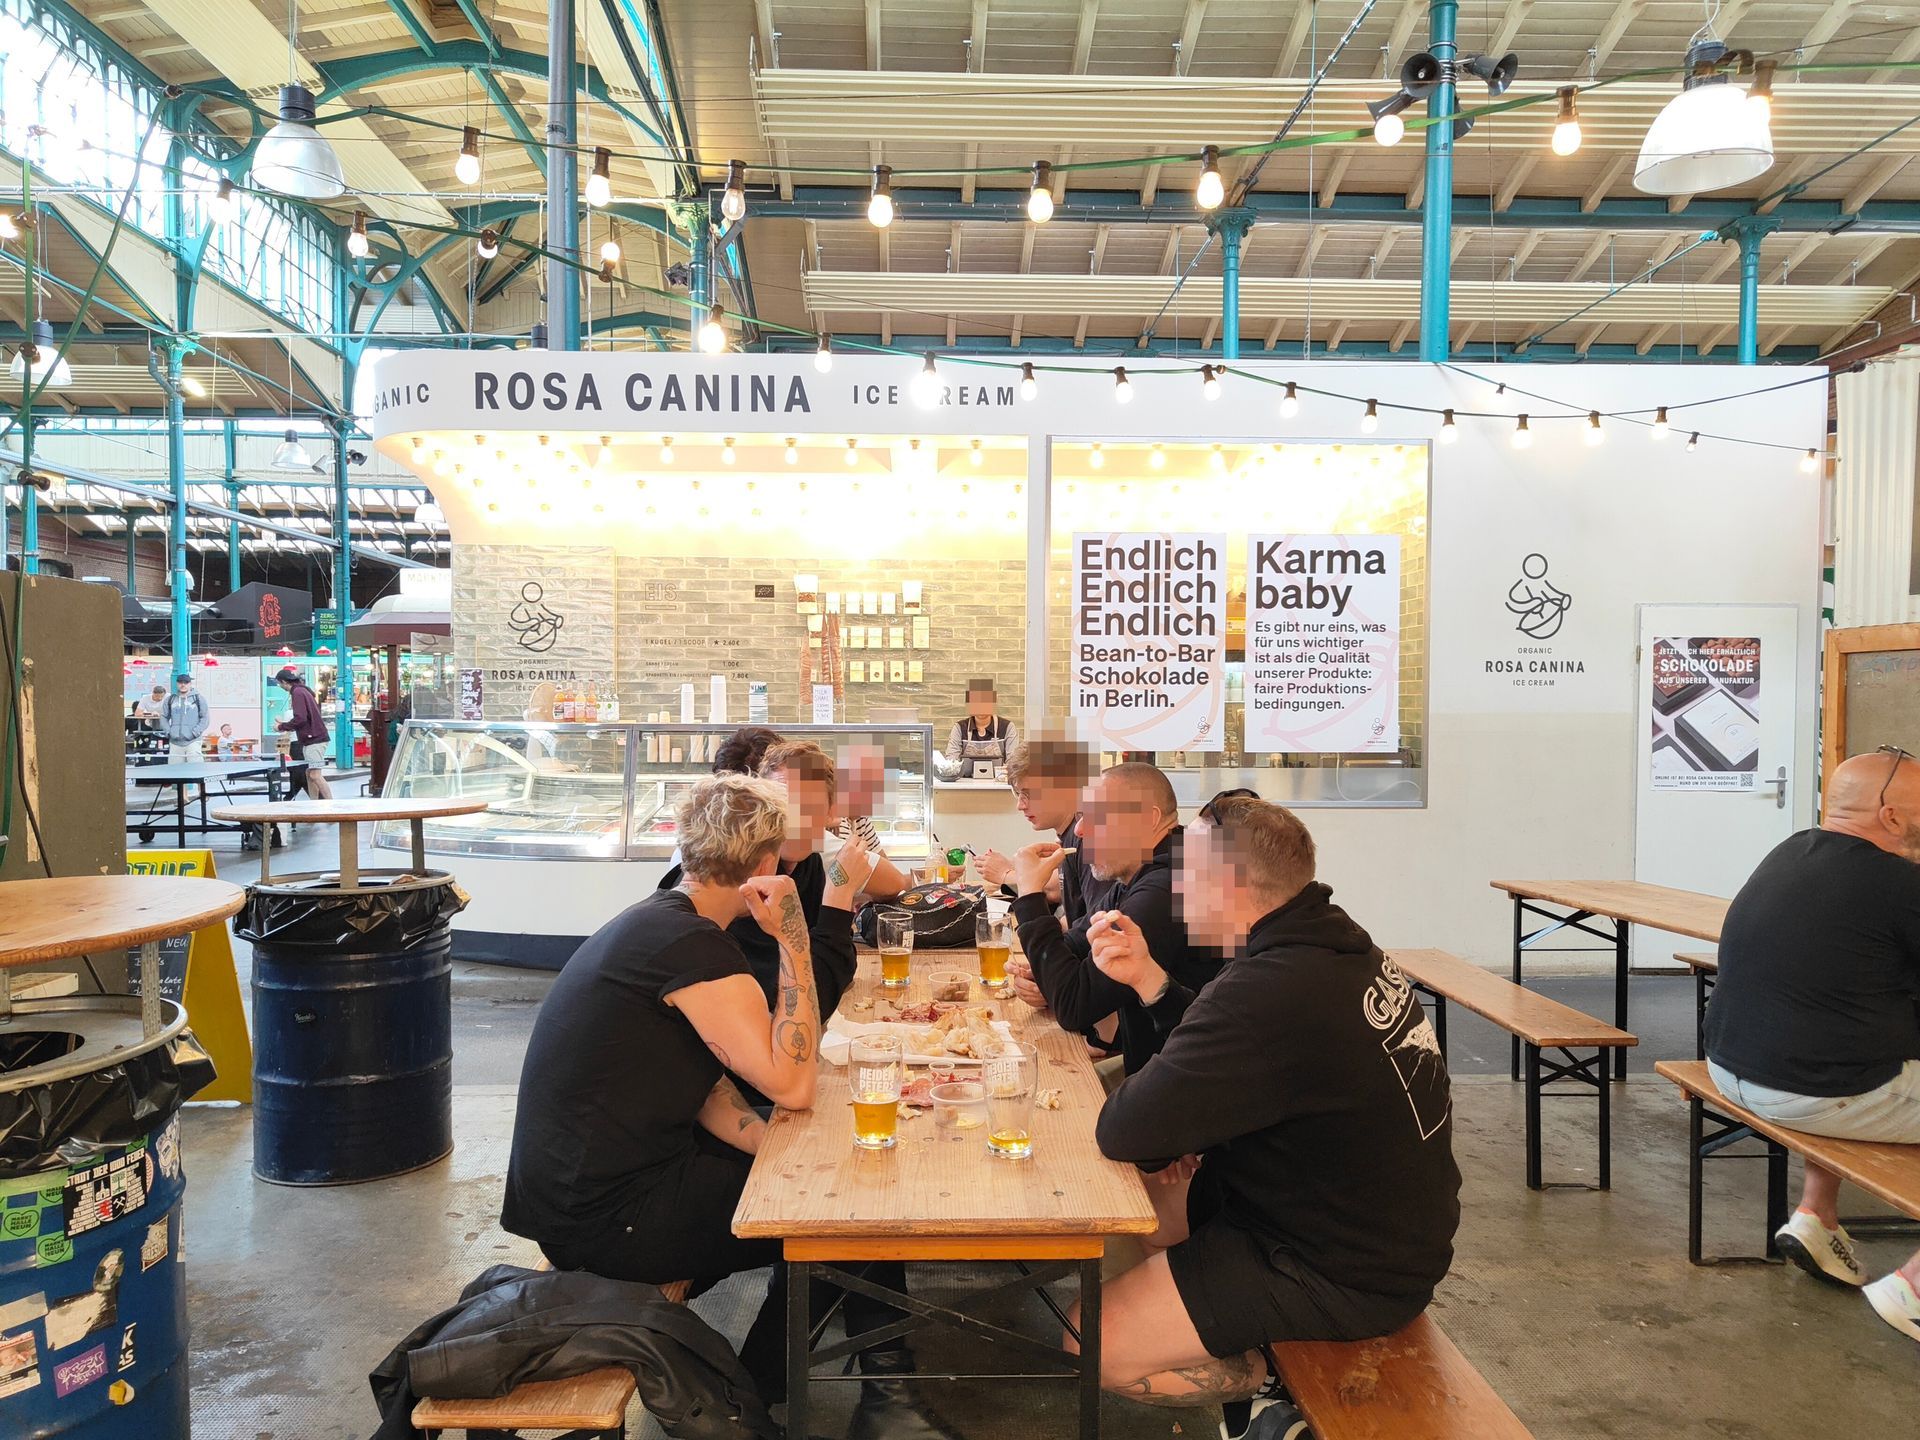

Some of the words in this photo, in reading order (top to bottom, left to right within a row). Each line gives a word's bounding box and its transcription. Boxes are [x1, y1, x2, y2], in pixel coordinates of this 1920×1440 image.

[474, 371, 603, 411] ROSA
[625, 372, 811, 413] CANINA
[853, 385, 898, 404] ICE
[925, 386, 1014, 406] REAM
[1081, 539, 1217, 571] Endlich
[1256, 541, 1386, 574] Karma
[645, 583, 677, 601] EIS
[1081, 572, 1217, 604] Endlich
[1255, 576, 1353, 618] baby
[1080, 605, 1216, 636] Endlich
[1255, 621, 1271, 633] Es
[1274, 621, 1300, 637] gibt
[1303, 623, 1325, 633] nur
[1328, 621, 1358, 635] eins,
[1361, 623, 1387, 633] was
[1254, 636, 1274, 648] für
[1276, 639, 1300, 648] uns
[1303, 636, 1365, 652] wichtiger
[1517, 647, 1553, 655] ORGANIC
[1699, 648, 1715, 656] HIER
[1080, 643, 1216, 663] Bean-to-Bar
[1255, 652, 1271, 664] ist
[1273, 652, 1293, 664] als
[1295, 652, 1316, 664] die
[1318, 651, 1371, 665] Qualität
[1254, 670, 1306, 680] unserer
[1308, 667, 1372, 680] Produkte:
[1485, 660, 1524, 673] ROSA
[1528, 660, 1585, 673] CANINA
[1660, 659, 1754, 673] SCHOKOLADE
[491, 670, 524, 681] ROSA
[528, 670, 577, 681] CANINA
[1079, 666, 1209, 686] Schokolade
[1512, 679, 1526, 687] ICE
[1527, 679, 1555, 687] CREAM
[1659, 677, 1674, 685] AUS
[1675, 677, 1707, 685] UNSERER
[1254, 682, 1284, 695] faire
[1287, 682, 1372, 695] Produktions-
[1080, 689, 1099, 708] in
[1105, 689, 1175, 708] Berlin.
[1254, 698, 1345, 712] bedingungen.
[93, 1164, 109, 1179] DER
